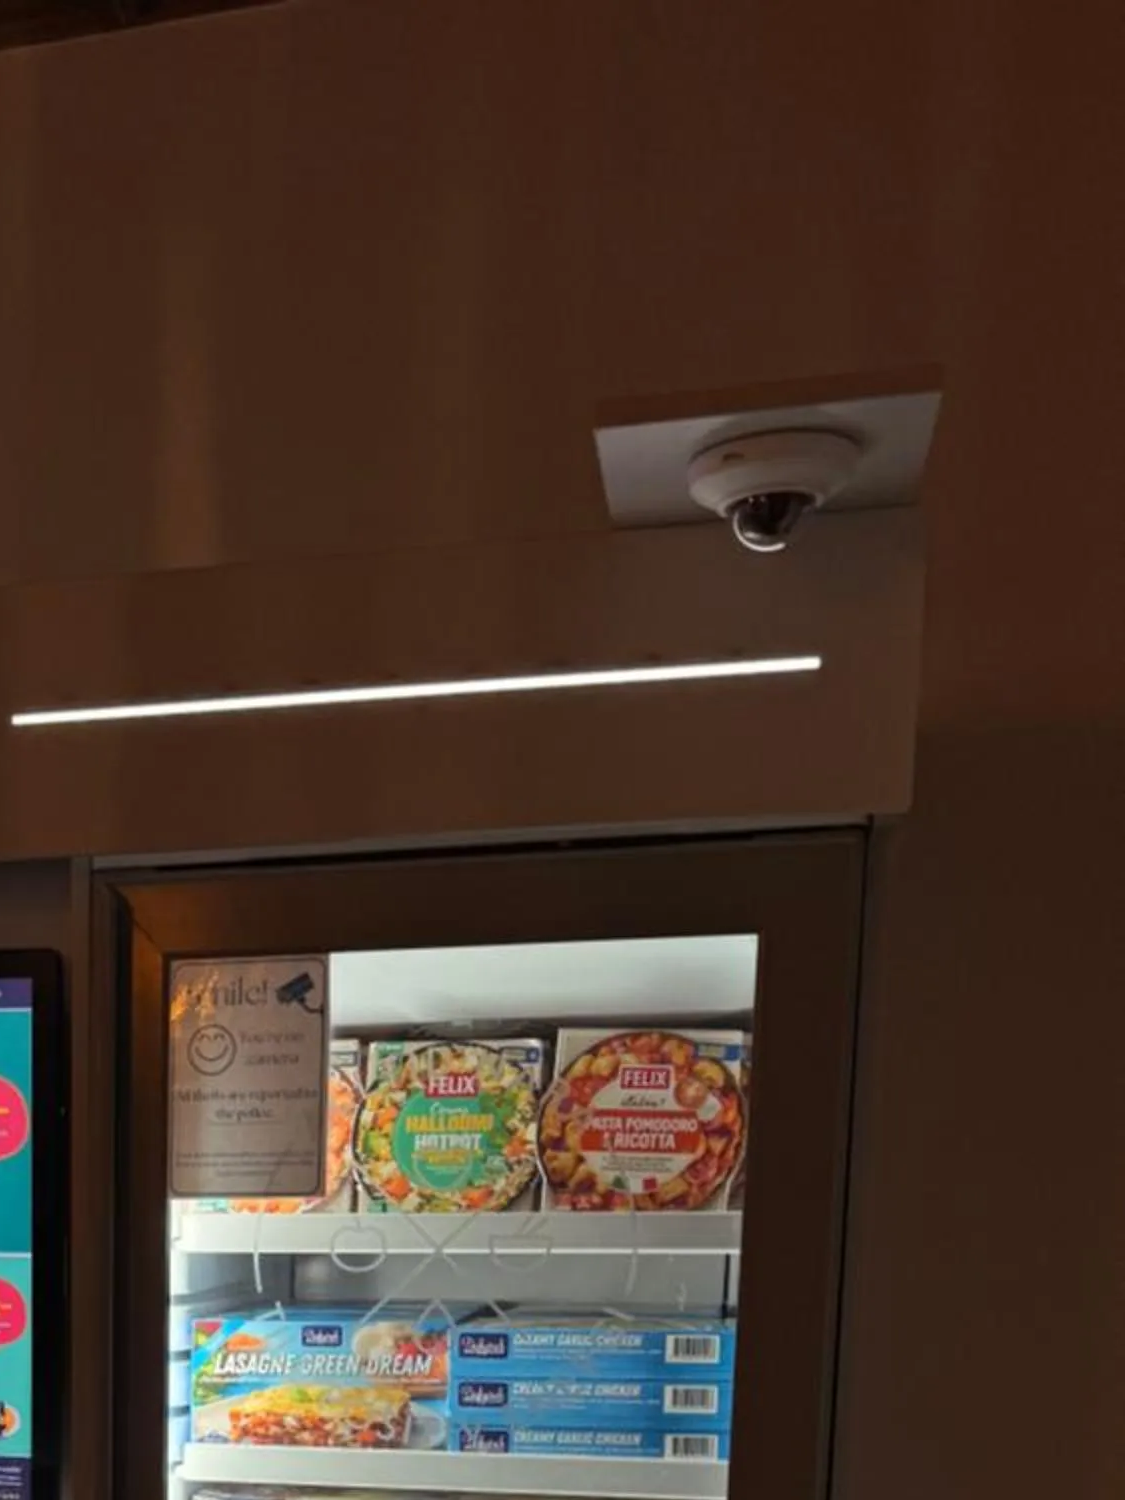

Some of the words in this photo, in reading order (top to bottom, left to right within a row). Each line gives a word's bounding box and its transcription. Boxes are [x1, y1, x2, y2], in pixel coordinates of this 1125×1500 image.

[427, 1076, 478, 1095] FELIX
[622, 1070, 669, 1088] FELIX
[586, 1116, 622, 1132] PASTA
[626, 1117, 699, 1133] POMODORO
[613, 1134, 676, 1150] RICOTTA
[214, 1352, 293, 1376] LASAGNE
[301, 1354, 361, 1376] GREEN
[366, 1355, 432, 1376] DREAM
